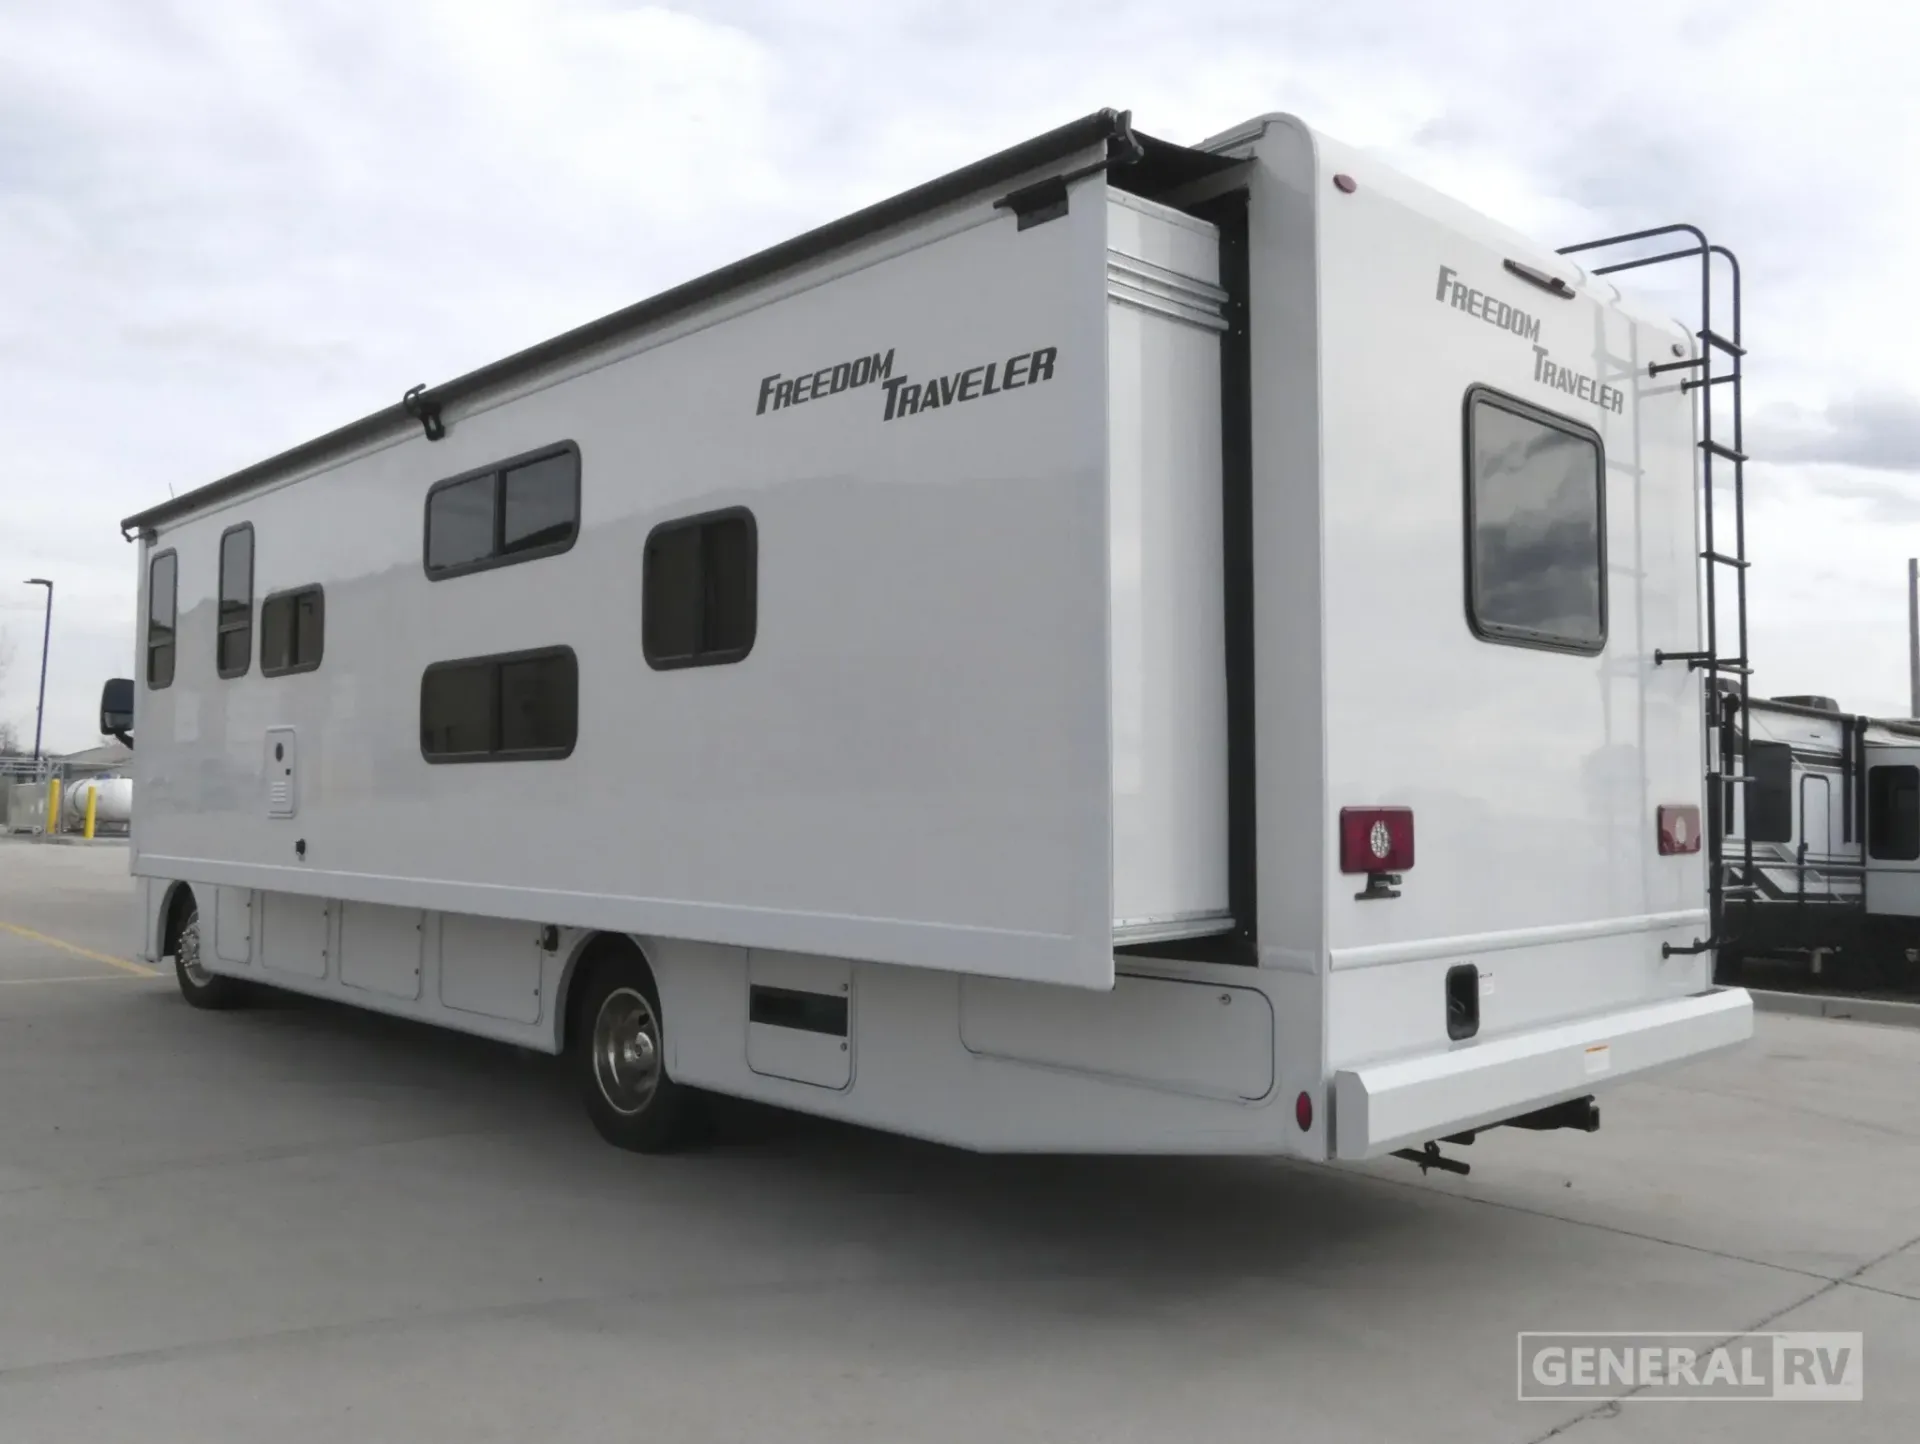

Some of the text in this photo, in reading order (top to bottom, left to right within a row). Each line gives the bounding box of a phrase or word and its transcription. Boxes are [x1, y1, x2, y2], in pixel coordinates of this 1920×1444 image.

[1436, 264, 1541, 343] FREEDOM
[756, 348, 895, 416] FREEDOM
[881, 346, 1057, 421] TRAVELER
[1532, 344, 1624, 415] TRAVELER
